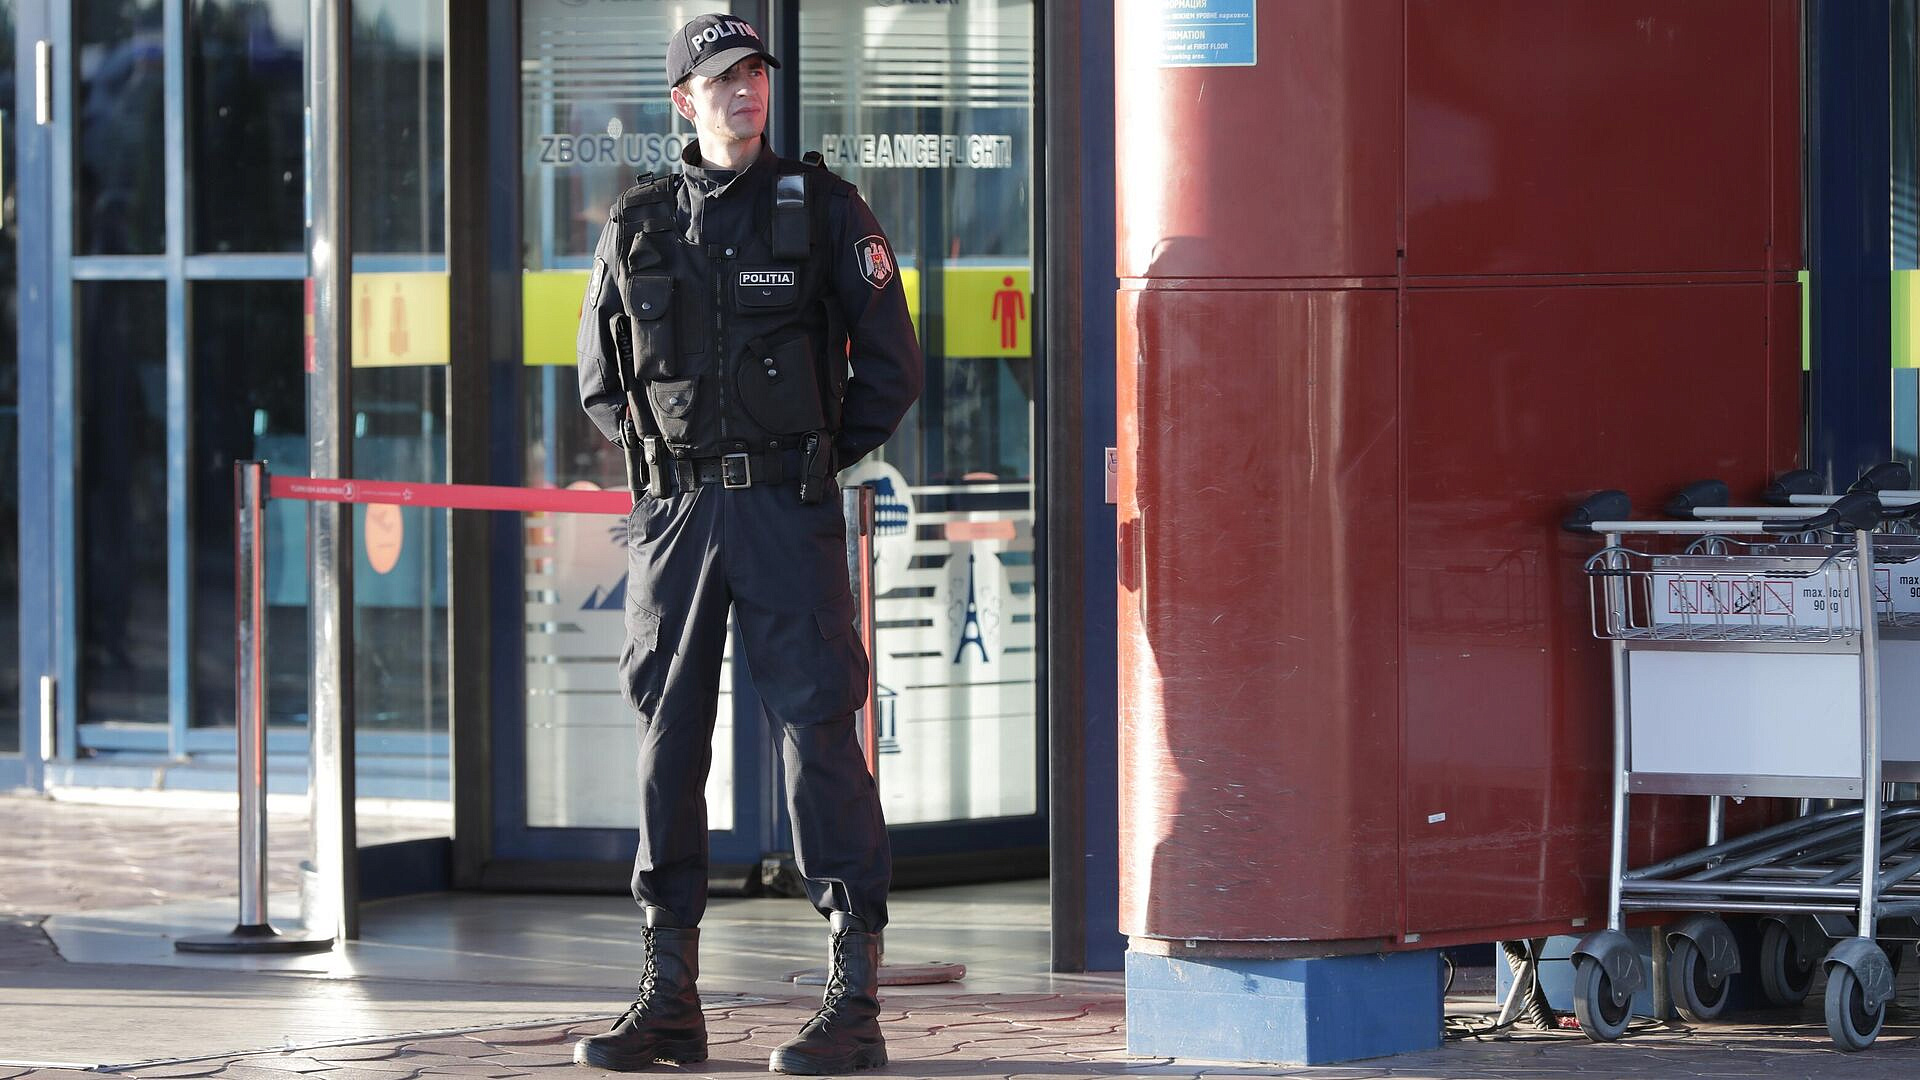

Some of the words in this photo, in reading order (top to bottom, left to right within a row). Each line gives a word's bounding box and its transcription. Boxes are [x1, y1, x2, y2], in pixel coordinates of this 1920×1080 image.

[539, 135, 617, 164] ZBOR
[625, 134, 697, 170] UȘO
[823, 134, 875, 167] HAVE
[876, 134, 895, 167] A
[1803, 588, 1825, 598] max.
[1814, 599, 1825, 611] 90
